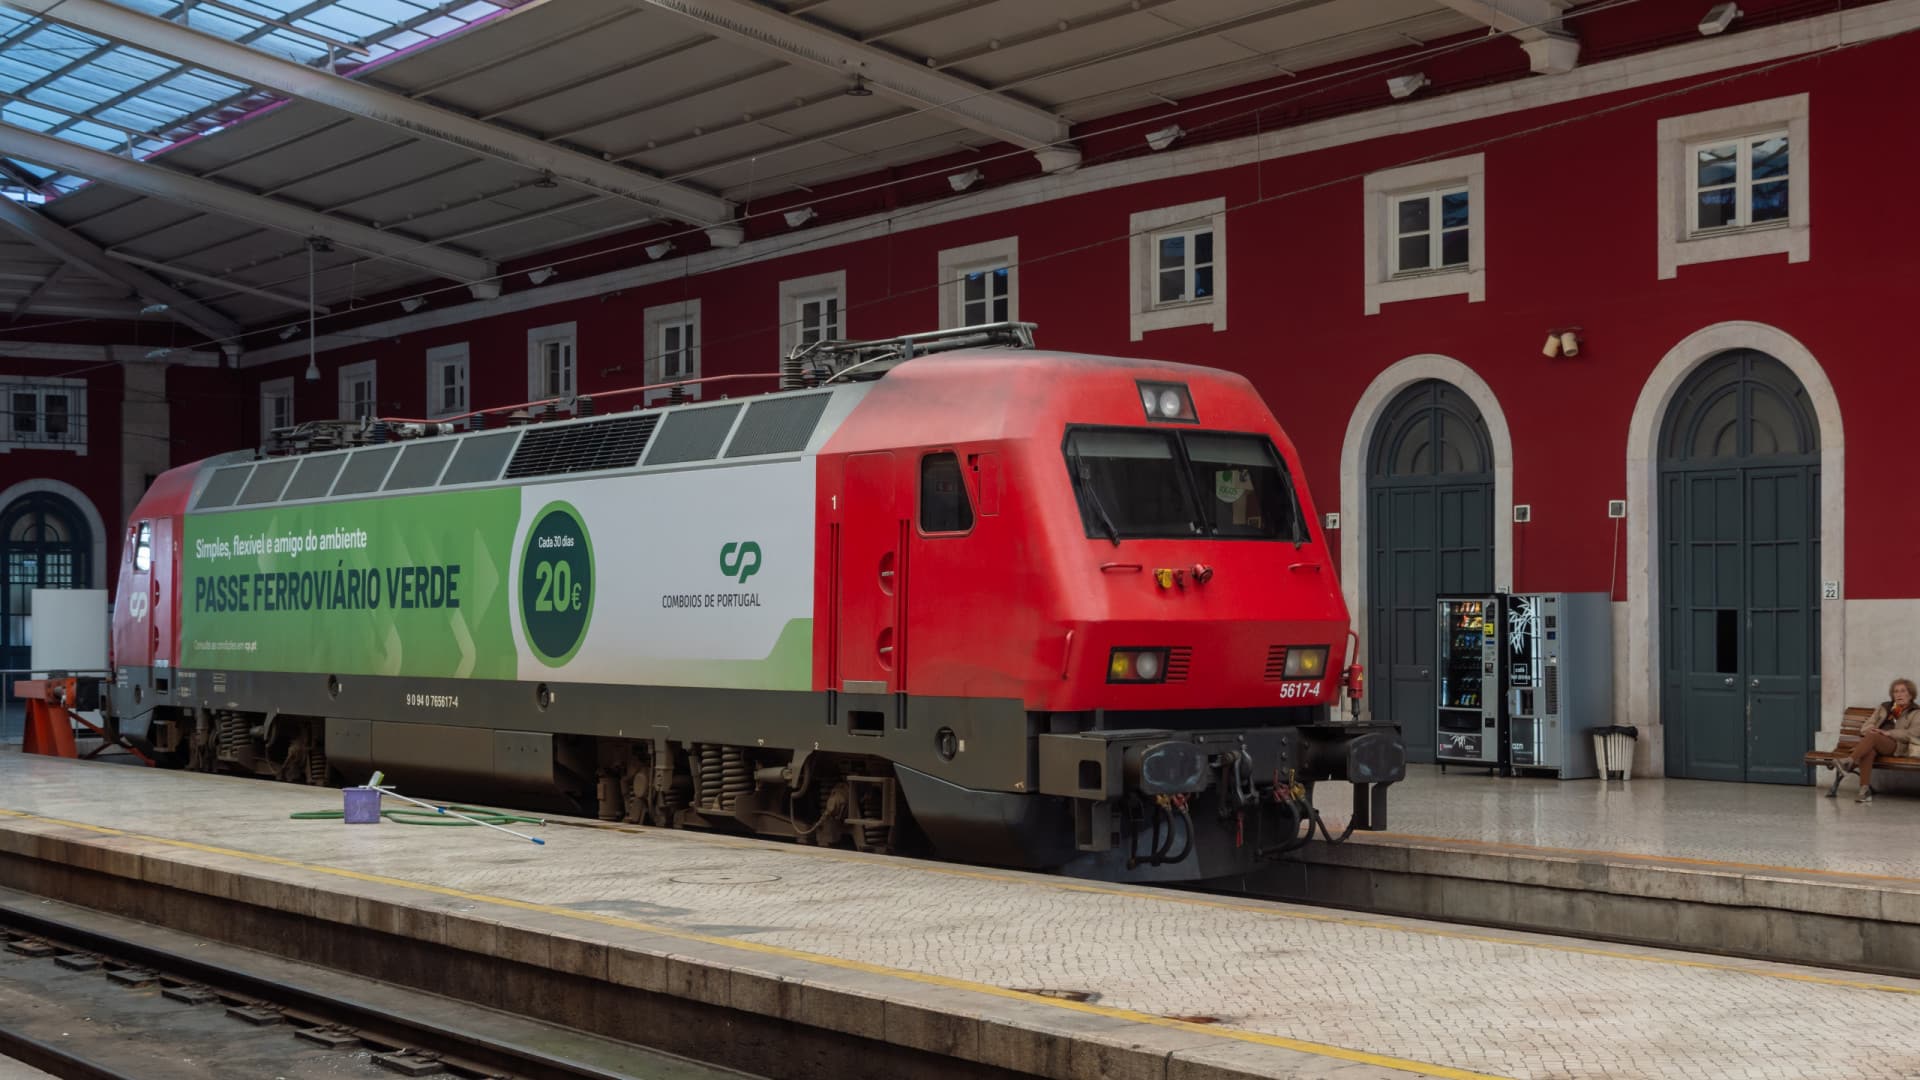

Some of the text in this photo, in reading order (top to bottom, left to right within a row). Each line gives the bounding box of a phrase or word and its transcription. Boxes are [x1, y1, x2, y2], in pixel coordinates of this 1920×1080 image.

[831, 495, 837, 510] 1
[196, 526, 367, 563] Simples, flexível e amigo do ambiente
[538, 535, 574, 548] Cada 30 dias
[195, 560, 461, 613] PASSE FERROVIÁRIO VERDE
[662, 593, 761, 608] COMBOIOS DE PORTUGAL
[1279, 682, 1321, 698] 5617-4
